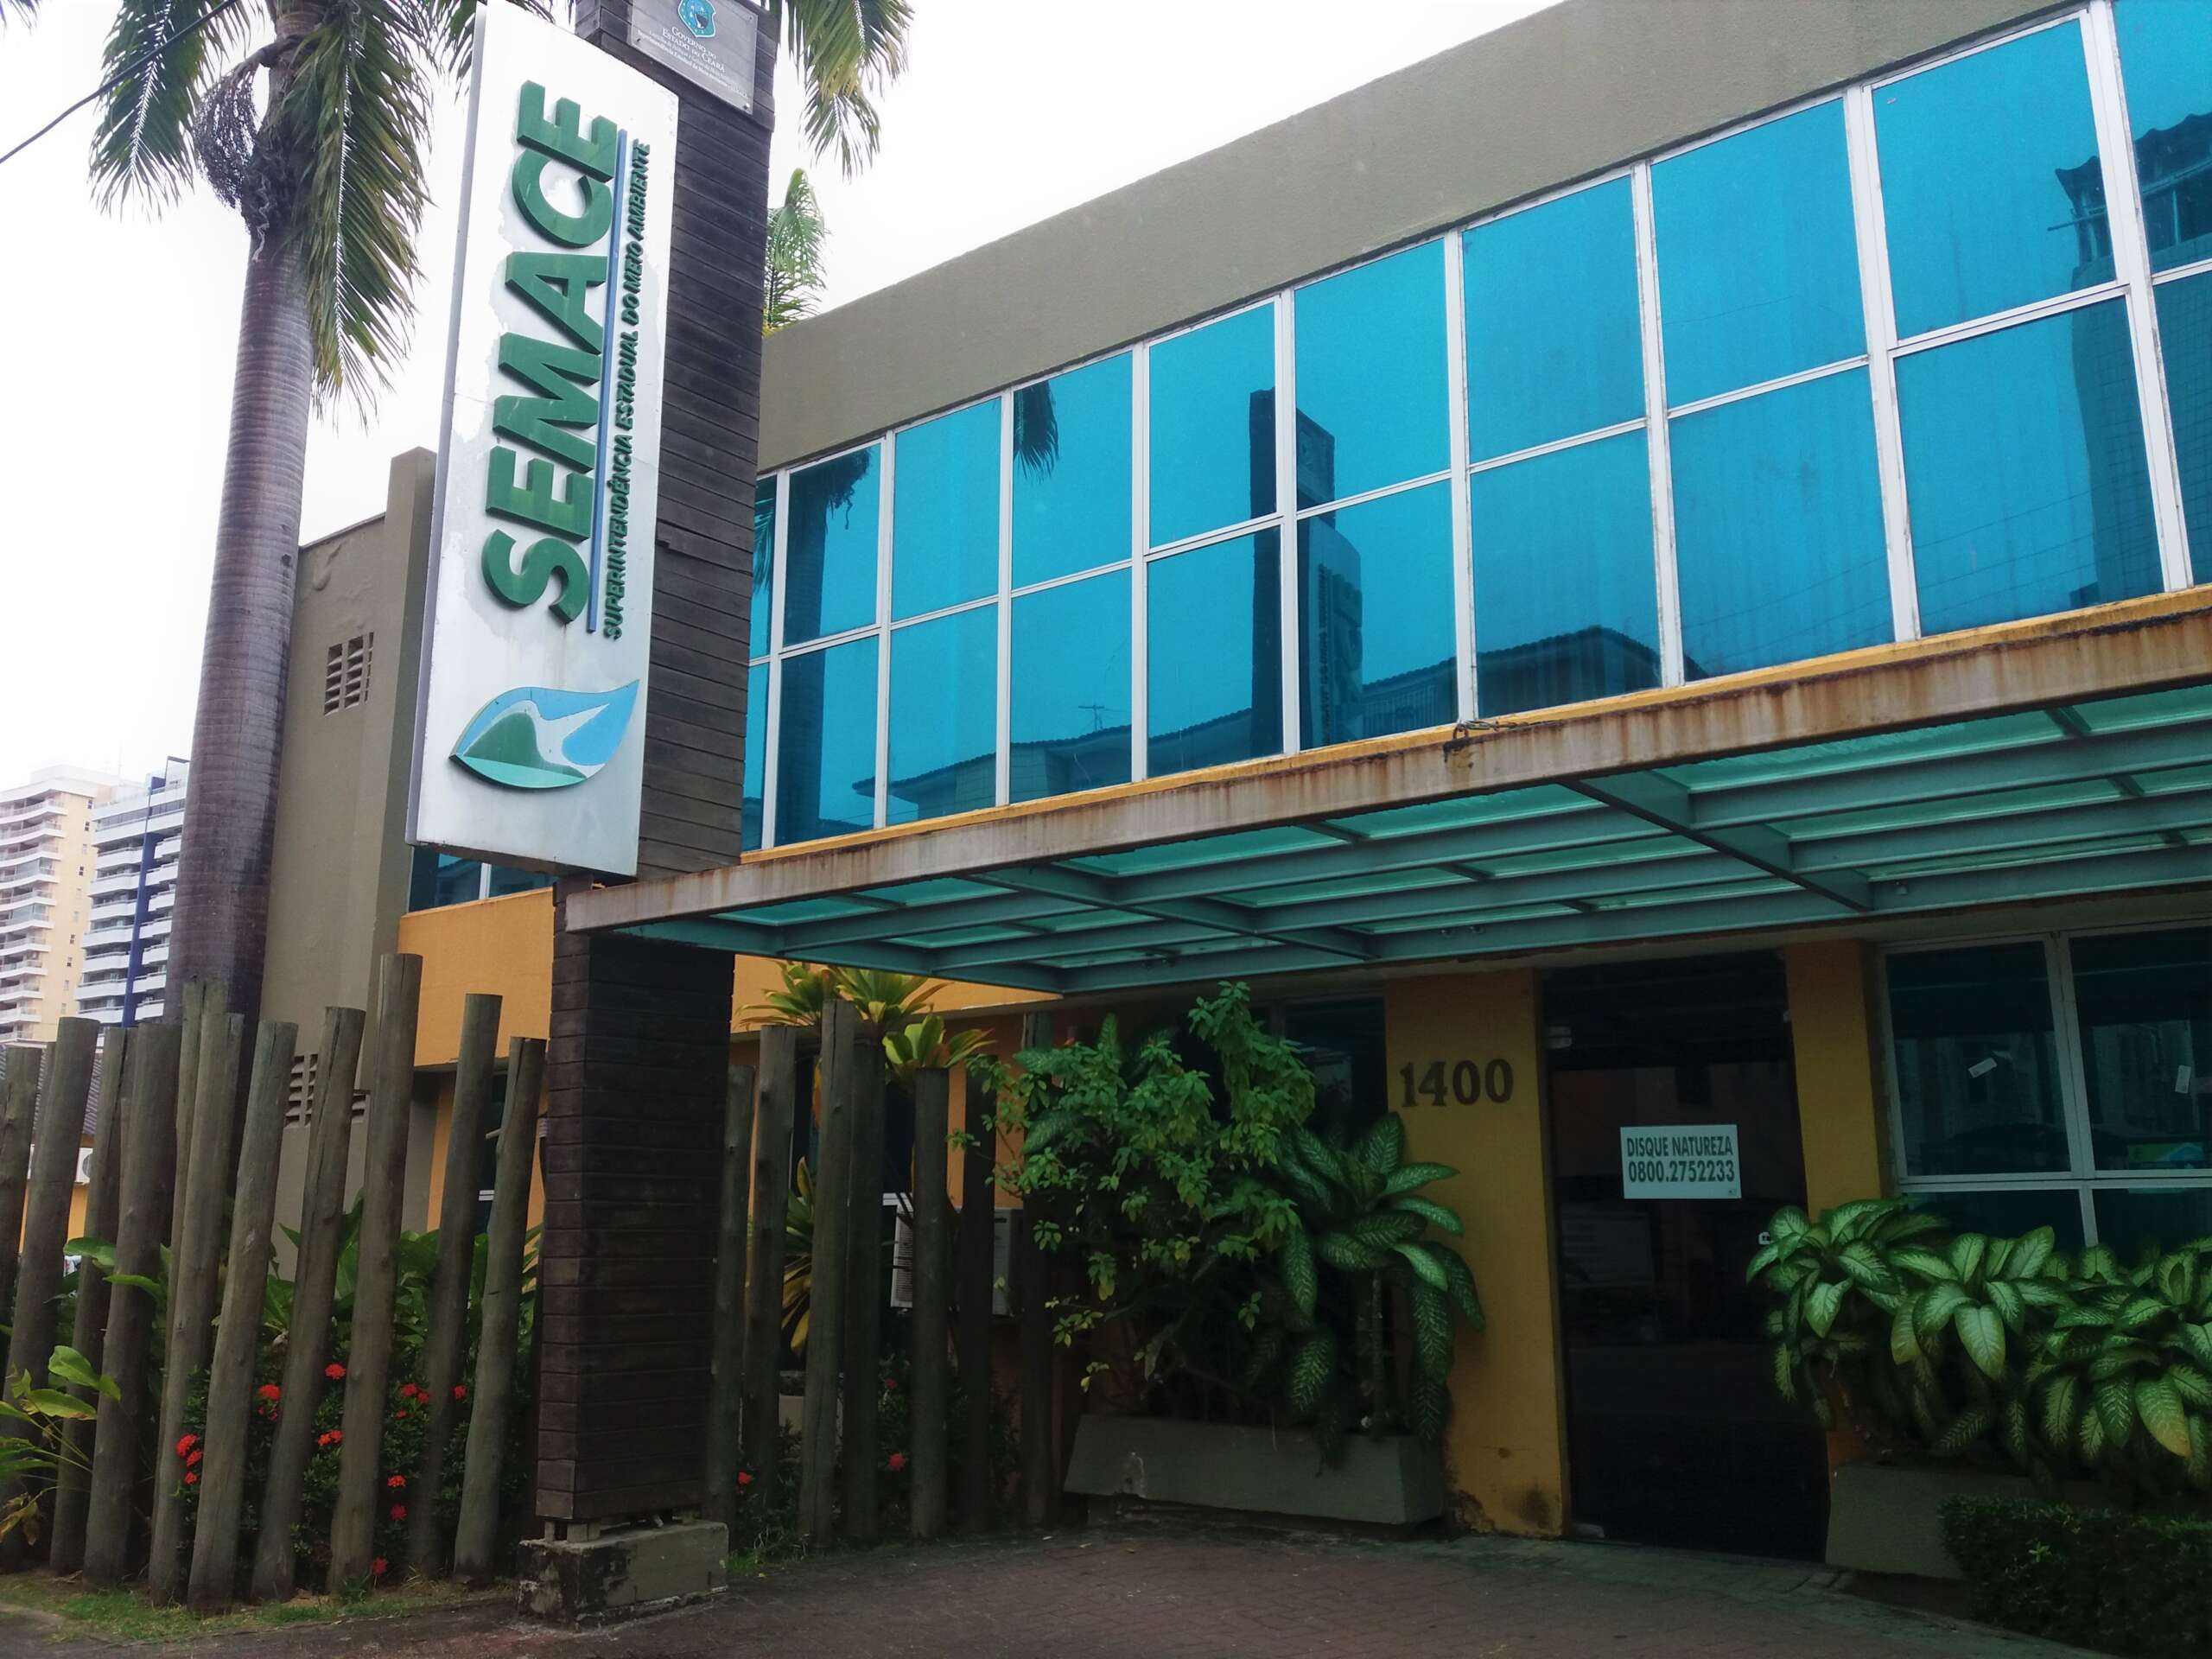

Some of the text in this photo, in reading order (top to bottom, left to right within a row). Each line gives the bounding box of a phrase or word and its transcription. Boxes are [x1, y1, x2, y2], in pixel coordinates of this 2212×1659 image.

[627, 138, 650, 241] AMBIENTE
[623, 241, 644, 294] MEIO
[621, 294, 640, 326] DO
[482, 79, 617, 623] SEMACE
[615, 330, 639, 430] ESTADUAL
[1400, 1058, 1514, 1108] 1400
[1627, 1136, 1733, 1158] DISQUE NATUREZA
[1629, 1160, 1735, 1182] 0800.2752233
